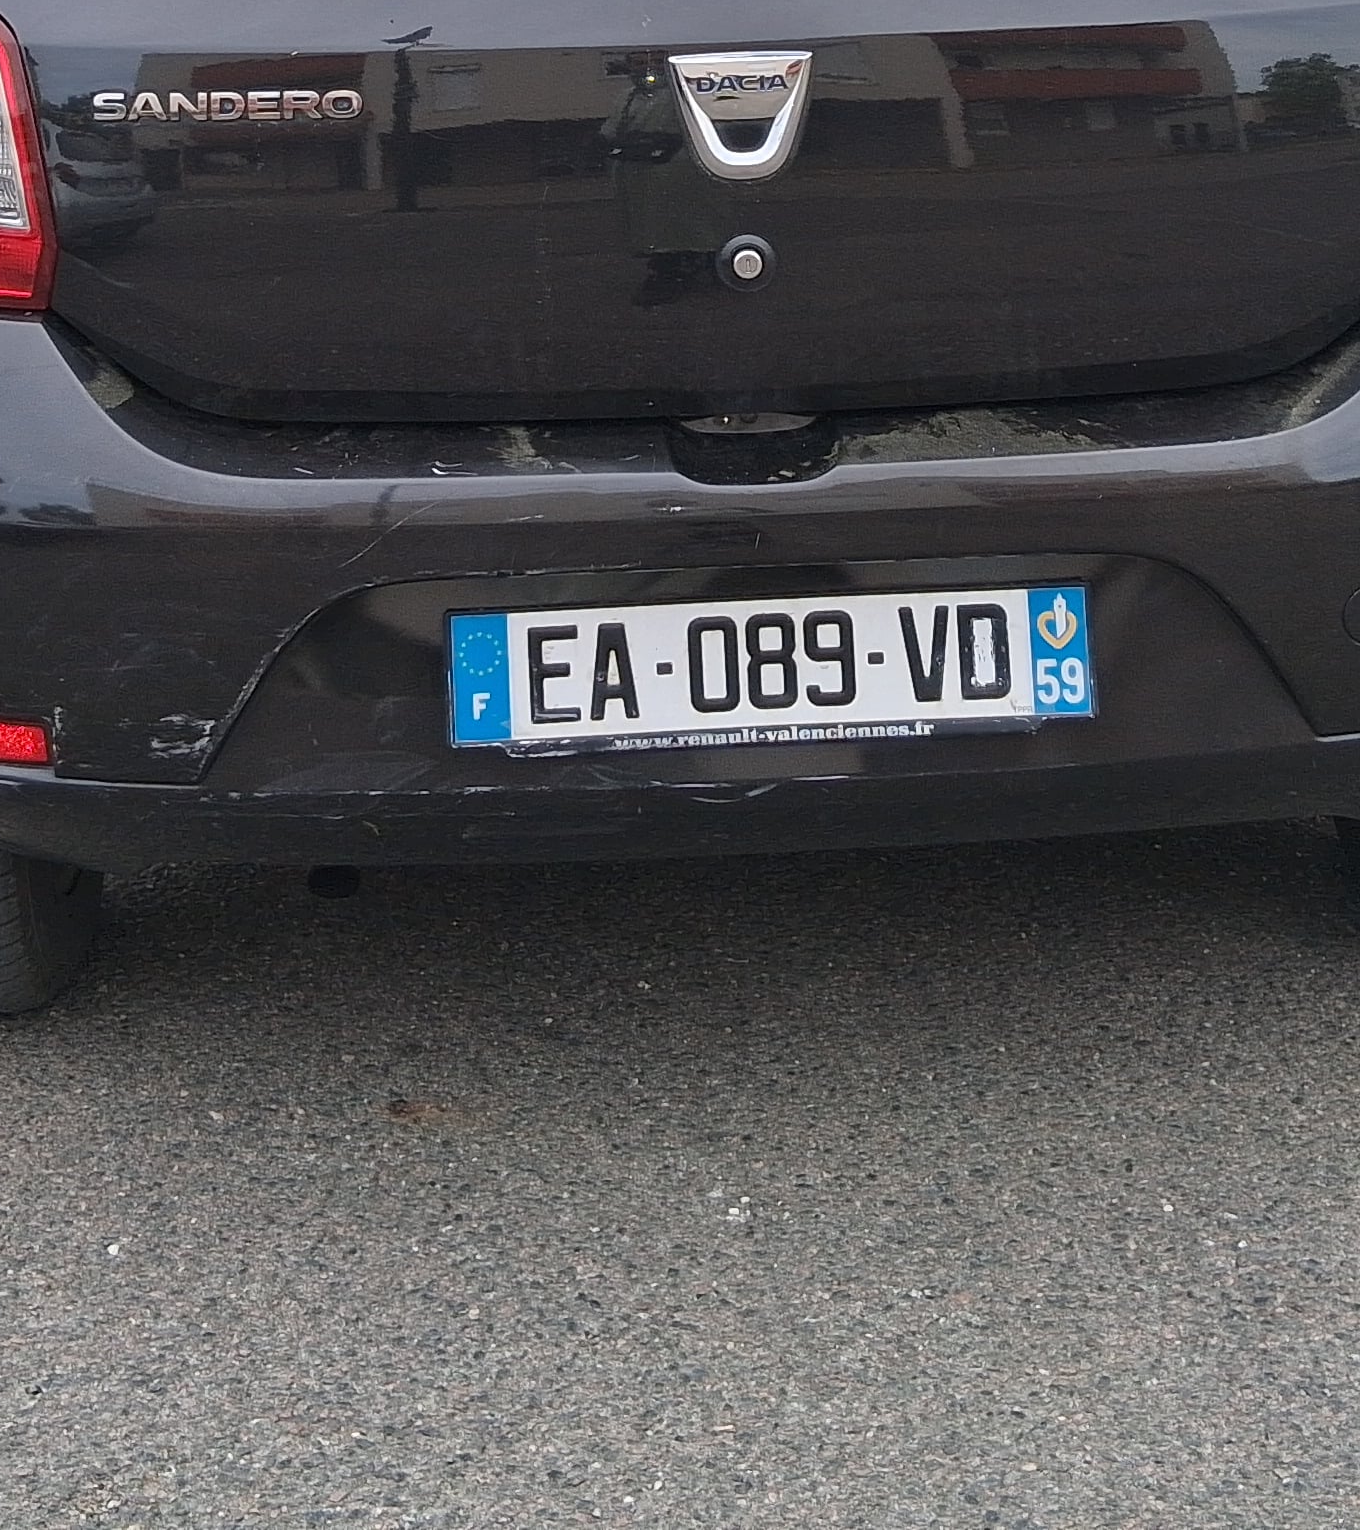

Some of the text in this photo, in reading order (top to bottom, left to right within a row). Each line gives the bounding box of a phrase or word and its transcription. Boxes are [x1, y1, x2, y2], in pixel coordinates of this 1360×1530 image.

[696, 74, 788, 92] DACIA
[92, 89, 364, 121] SANDERO
[471, 603, 1086, 724] F EA-089-VD 59
[610, 720, 935, 751] www.renault-valenciennes.fr
